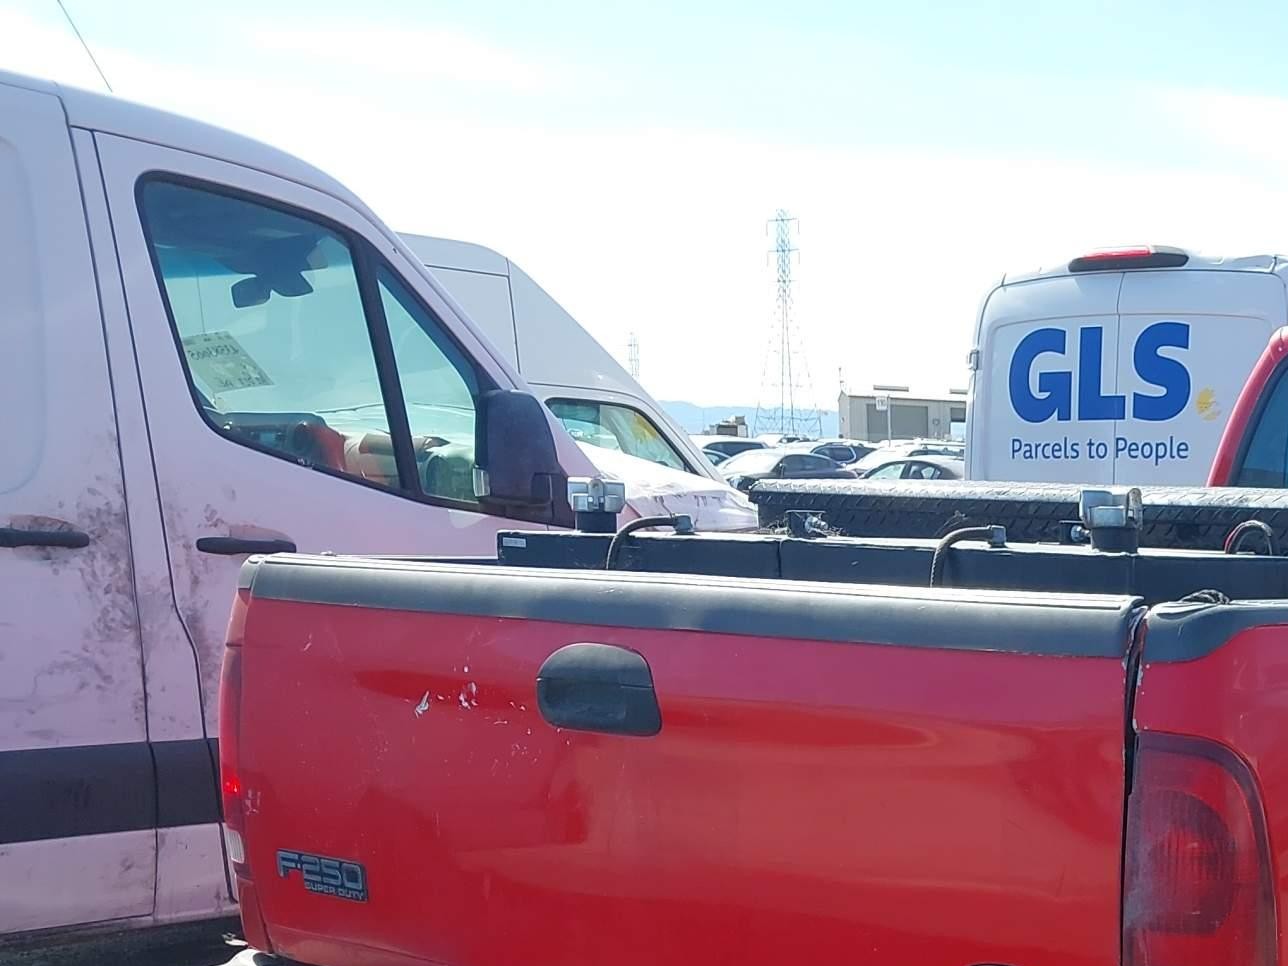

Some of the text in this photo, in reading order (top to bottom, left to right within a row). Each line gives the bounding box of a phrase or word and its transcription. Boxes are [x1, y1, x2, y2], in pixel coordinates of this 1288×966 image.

[1009, 321, 1192, 424] GLS
[1011, 436, 1189, 466] Parcels to People
[304, 881, 365, 900] SUPER DUTY
